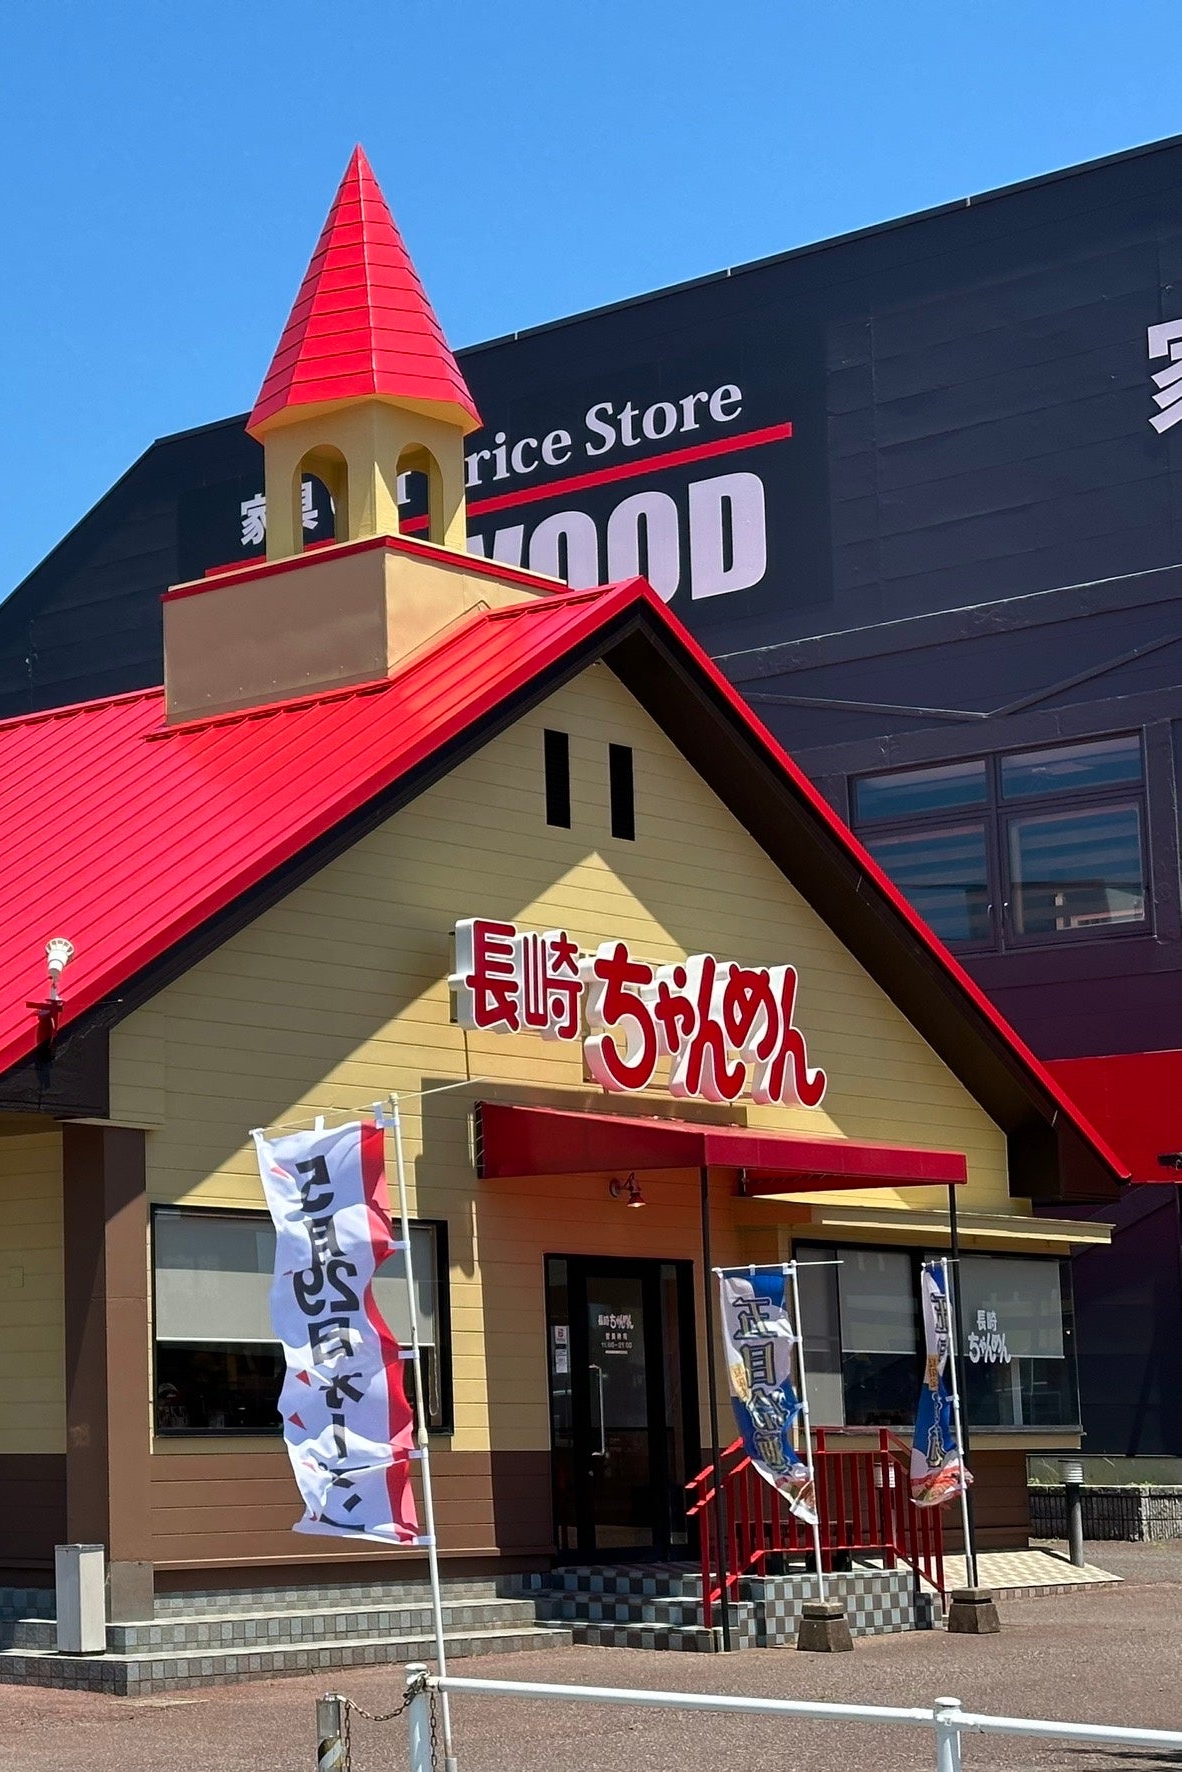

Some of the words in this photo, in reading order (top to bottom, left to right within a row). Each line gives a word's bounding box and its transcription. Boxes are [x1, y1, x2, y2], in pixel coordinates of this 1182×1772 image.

[465, 428, 573, 487] rice
[585, 382, 743, 456] Store
[464, 918, 828, 1108] 長崎ちゃんめん
[967, 1331, 1012, 1364] ちゃんめん
[976, 1309, 997, 1332] 長崎
